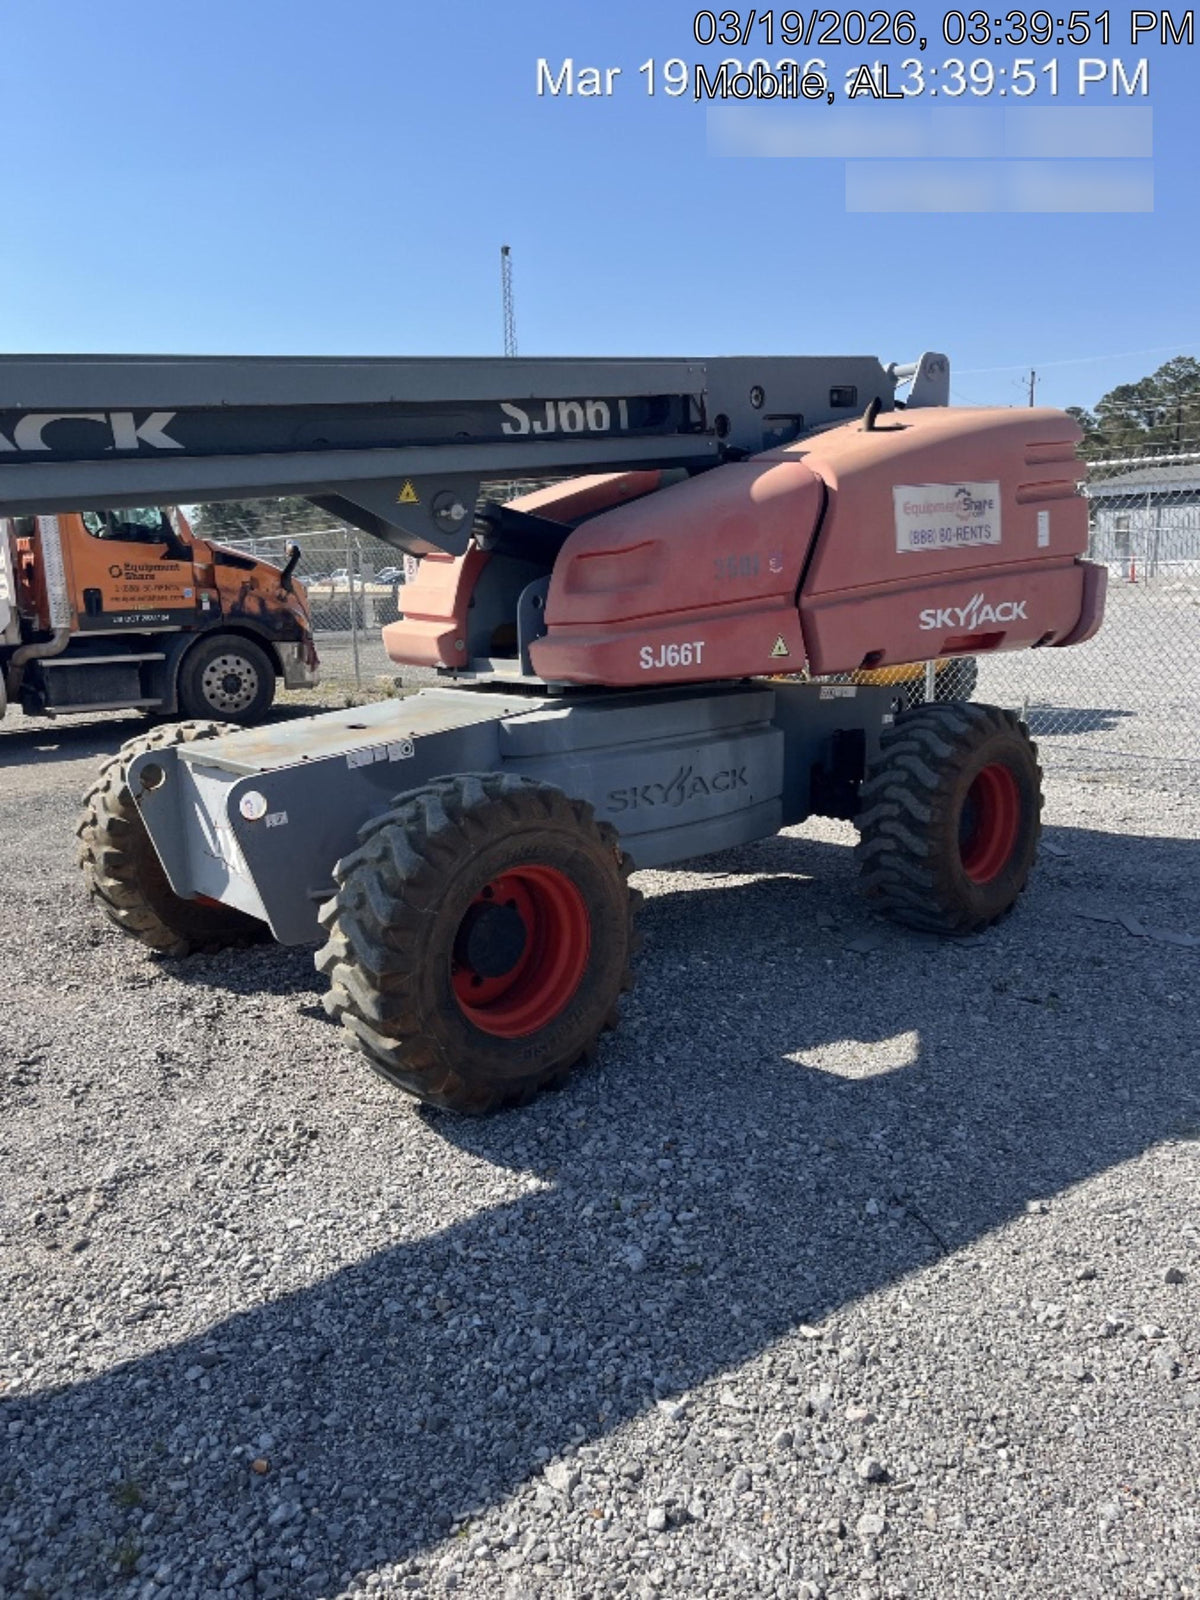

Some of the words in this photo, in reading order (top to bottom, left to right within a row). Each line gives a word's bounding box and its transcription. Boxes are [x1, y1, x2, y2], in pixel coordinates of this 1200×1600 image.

[0, 412, 187, 451] CK
[919, 592, 1029, 631] SKYJACK
[639, 641, 705, 669] SJ66T
[606, 765, 749, 813] SKYJACK
